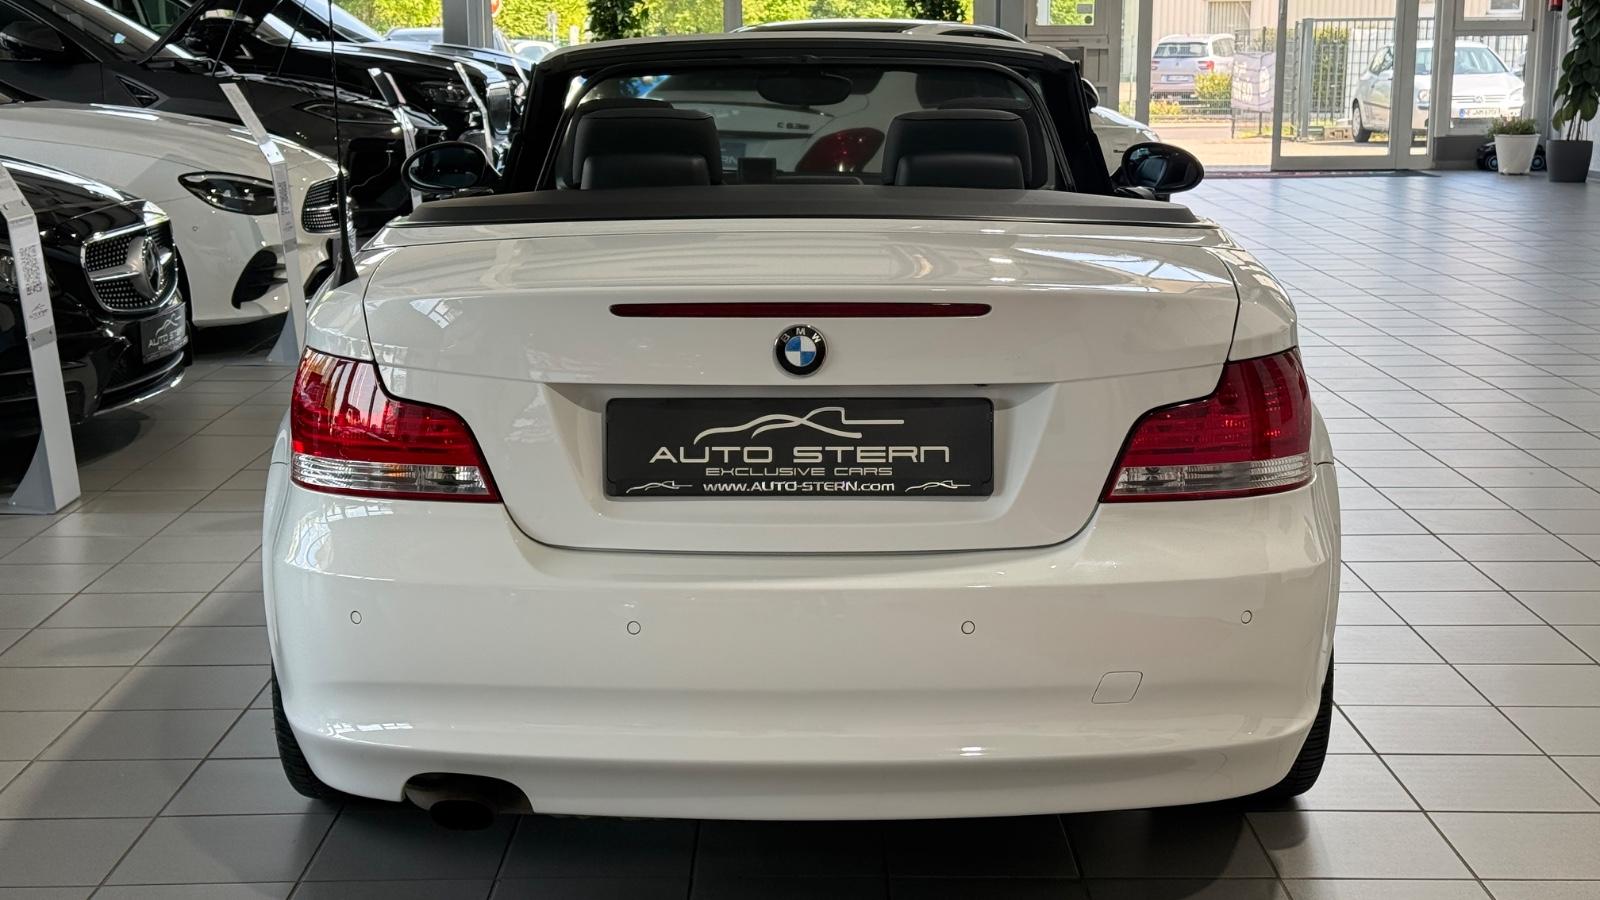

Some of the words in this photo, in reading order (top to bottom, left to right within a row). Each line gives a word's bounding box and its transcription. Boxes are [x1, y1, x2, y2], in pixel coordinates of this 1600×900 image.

[780, 327, 822, 343] BMW
[649, 446, 773, 464] AUTO
[793, 446, 950, 464] STERN
[705, 467, 825, 476] EXCLUSIVE
[834, 467, 893, 476] CARS
[703, 480, 895, 492] www.AUTO-STERN.com
